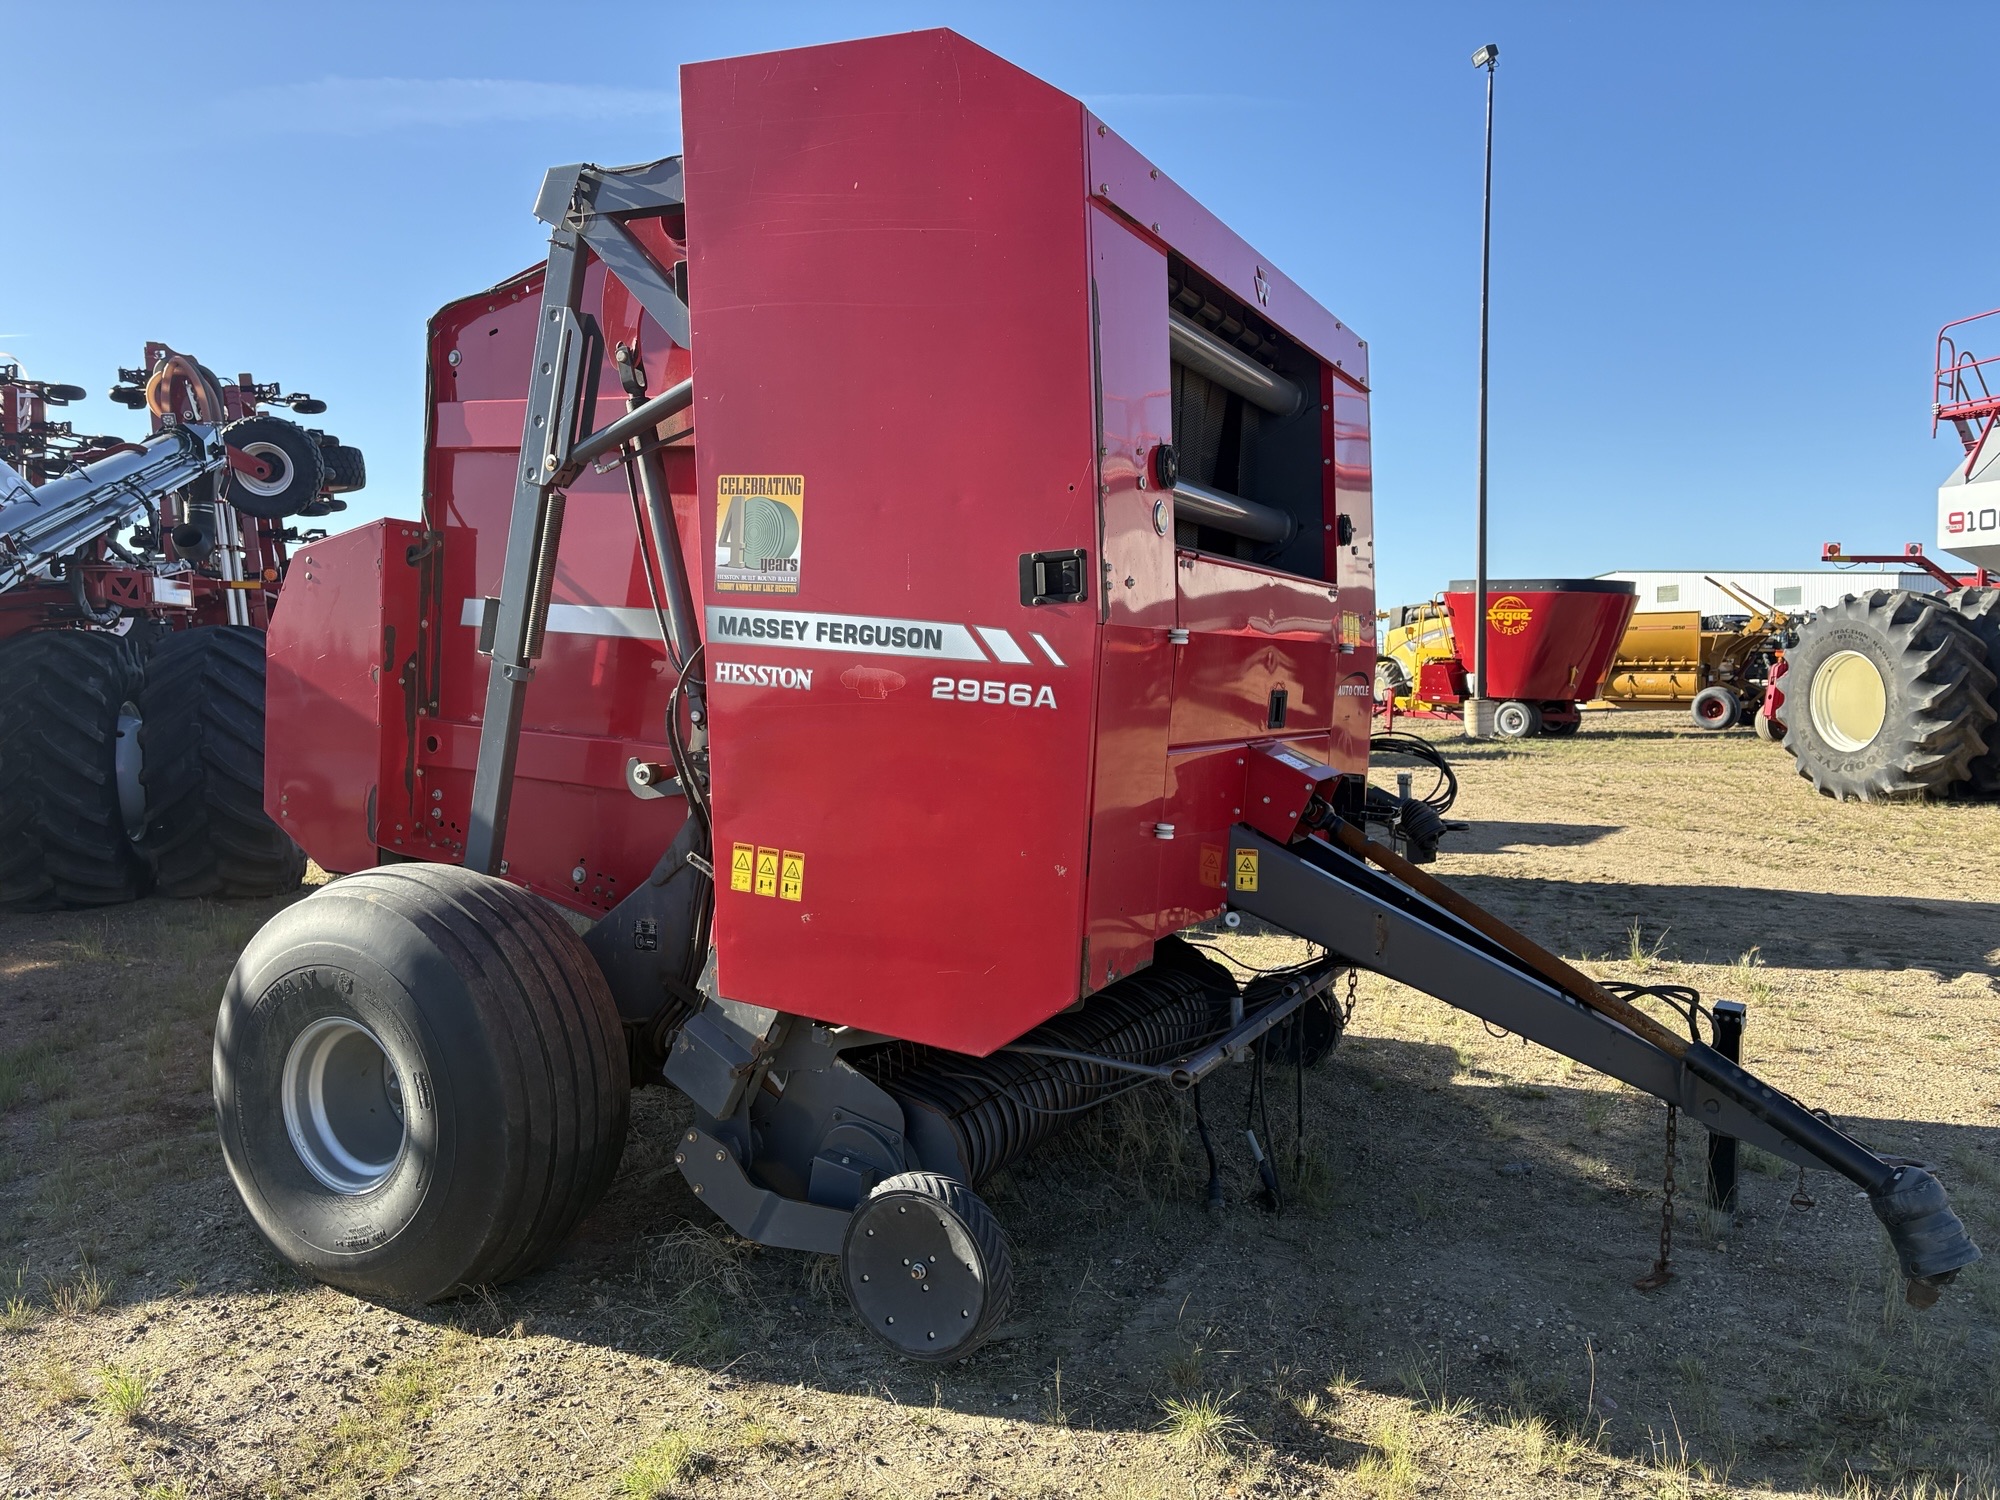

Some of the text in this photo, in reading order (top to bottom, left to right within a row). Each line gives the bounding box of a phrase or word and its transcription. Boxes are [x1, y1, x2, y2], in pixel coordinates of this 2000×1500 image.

[720, 477, 801, 495] CELEBRATING
[1949, 508, 2000, 533] 910
[760, 558, 798, 573] years
[1486, 608, 1533, 626] Segue
[718, 615, 943, 650] MASSEY FERGUSON
[1829, 628, 1869, 640] TRACTION
[1872, 640, 1895, 673] RADIAL
[714, 662, 813, 690] HESSTON
[931, 677, 1058, 710] 2956A
[1337, 685, 1370, 696] AUTO CYCLE
[1800, 729, 1886, 773] GOODYEAR
